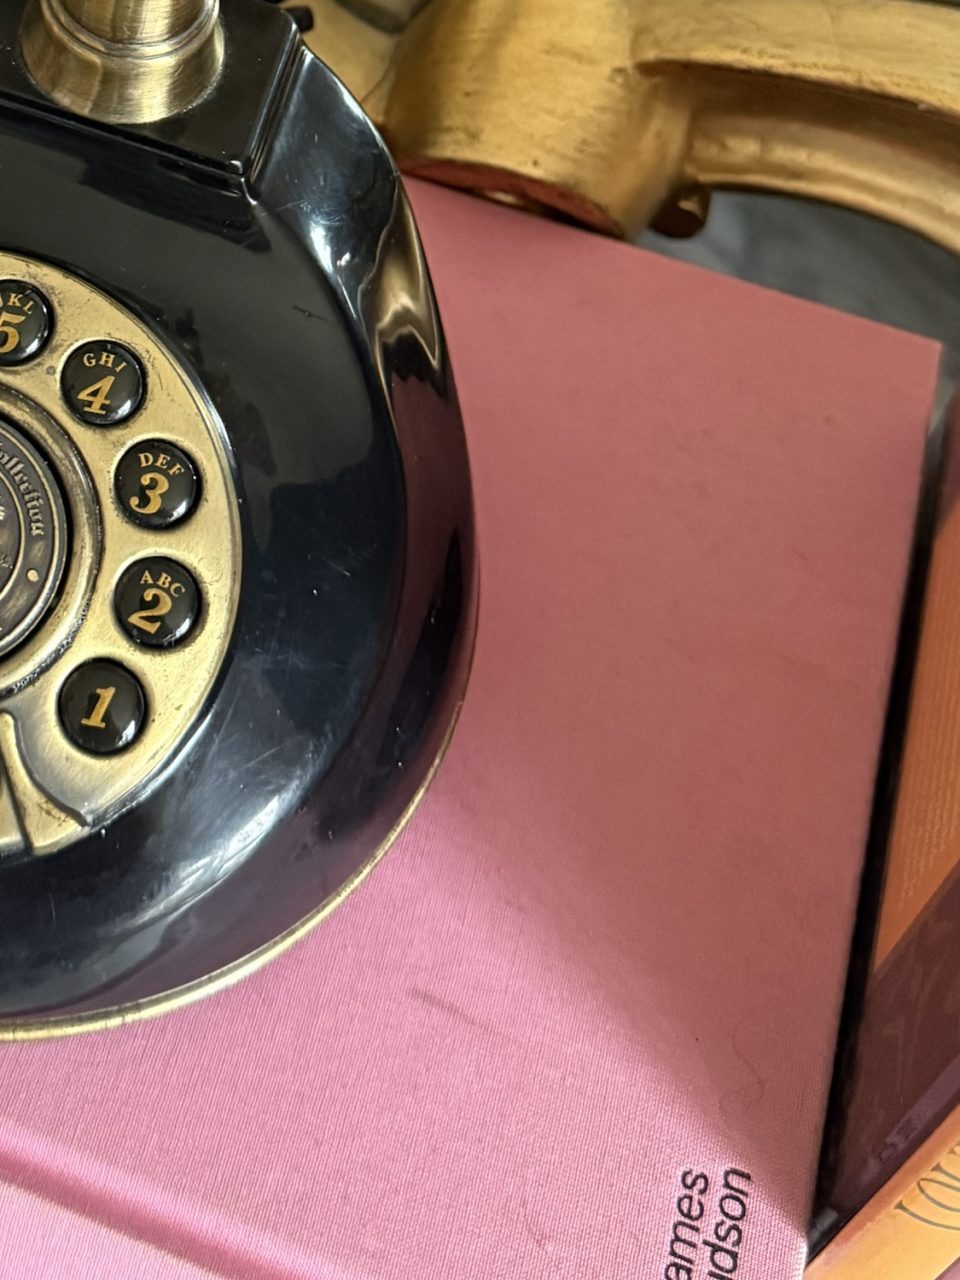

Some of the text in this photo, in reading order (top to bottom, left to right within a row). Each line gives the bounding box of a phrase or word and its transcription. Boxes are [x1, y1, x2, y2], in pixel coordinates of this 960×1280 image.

[82, 352, 127, 374] GHI
[76, 374, 116, 416] 4
[138, 451, 185, 477] DEF
[128, 471, 170, 516] 3
[140, 570, 187, 598] ABC
[127, 587, 173, 635] 2
[80, 685, 117, 730] 1
